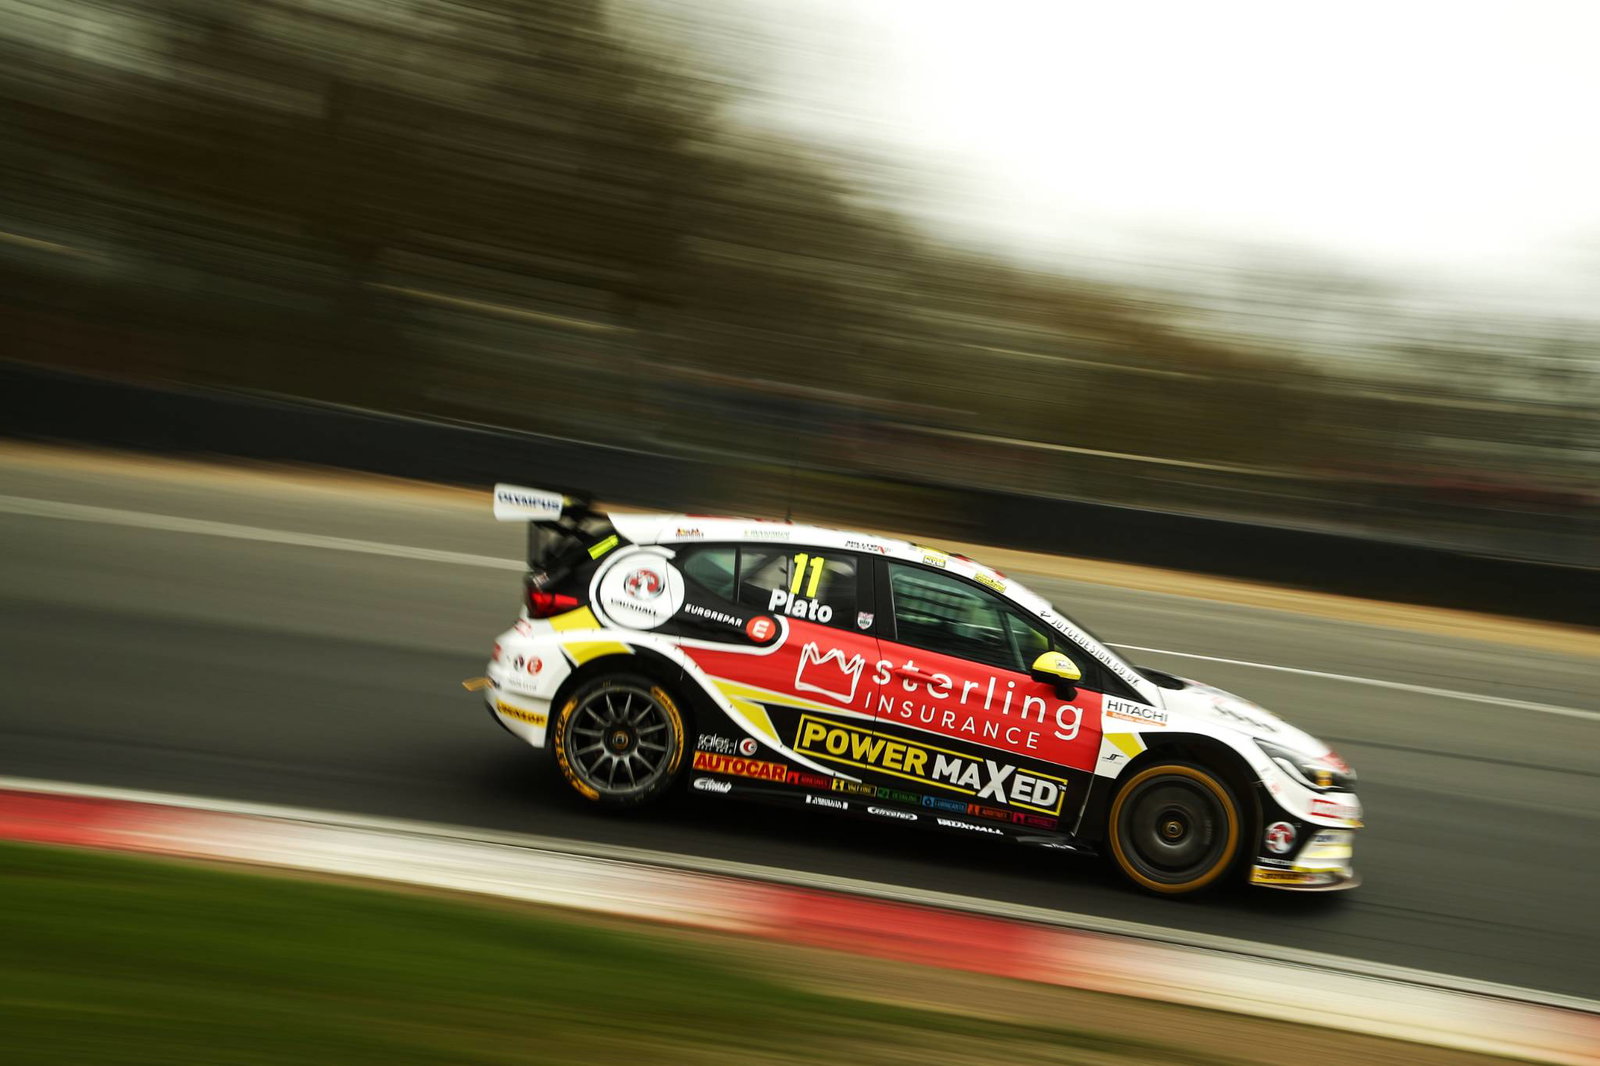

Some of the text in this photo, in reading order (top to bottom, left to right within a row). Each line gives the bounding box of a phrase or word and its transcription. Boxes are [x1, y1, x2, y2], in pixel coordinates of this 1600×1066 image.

[790, 553, 825, 598] 11
[684, 603, 743, 628] EUROREPAR
[768, 588, 833, 624] Plato
[752, 619, 770, 638] E
[872, 659, 1084, 741] sterling
[1107, 700, 1168, 723] HITACHI
[864, 691, 1041, 750] INSURANCE
[694, 752, 786, 781] AUTOCAR
[802, 721, 929, 777] POWER
[932, 754, 1060, 807] MAXED
[937, 817, 1004, 835] VAUXHALL
